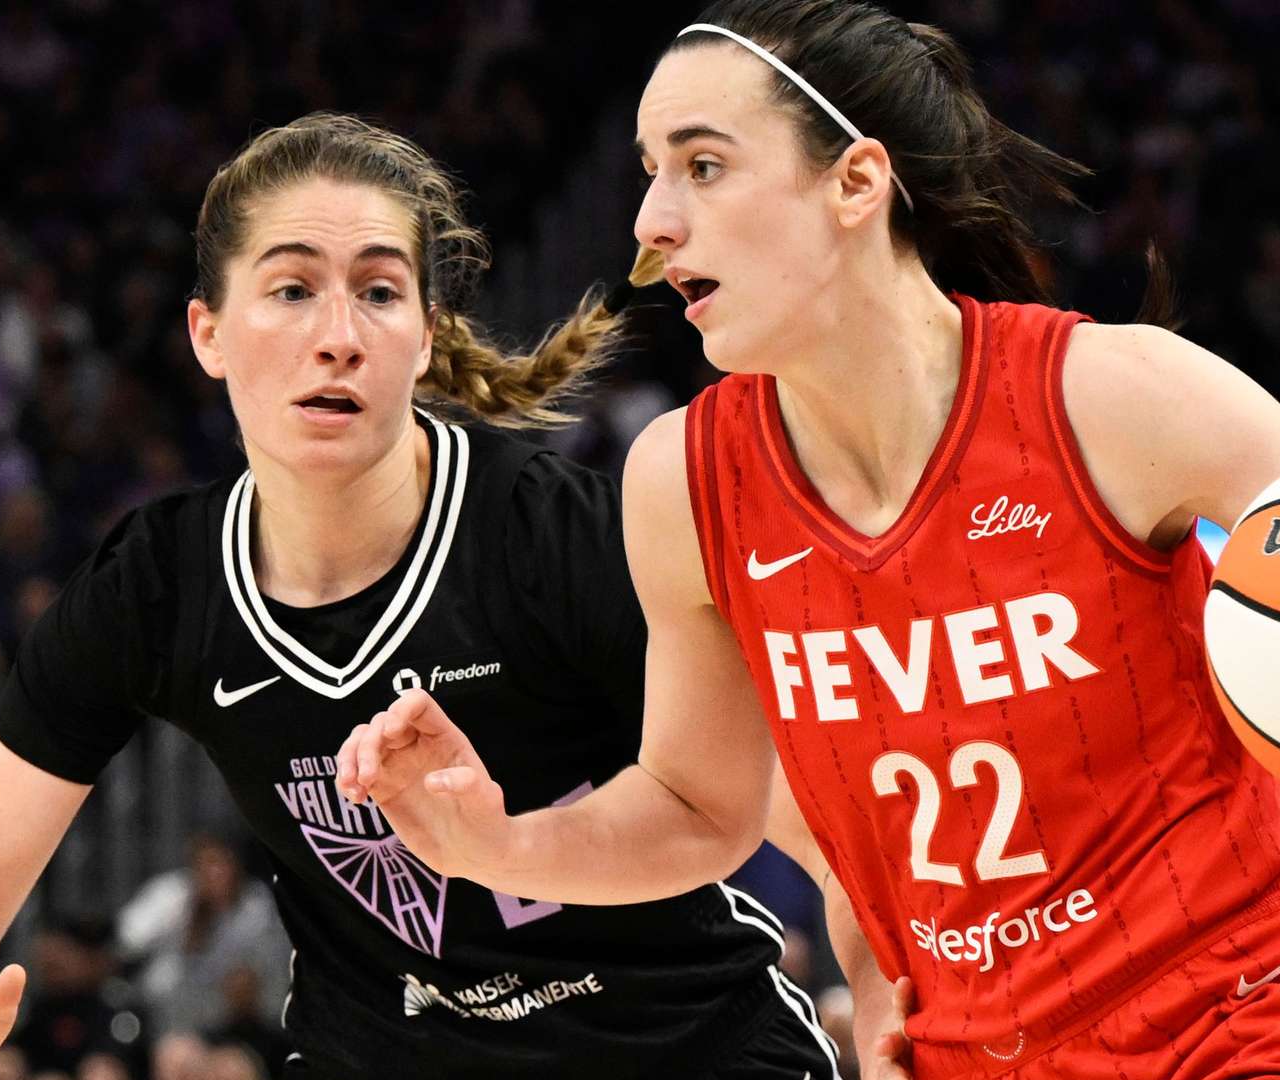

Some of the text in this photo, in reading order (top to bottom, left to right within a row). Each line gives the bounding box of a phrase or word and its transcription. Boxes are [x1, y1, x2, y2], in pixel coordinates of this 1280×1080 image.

[966, 494, 1053, 540] Lilly
[429, 661, 501, 692] freedom
[762, 591, 1102, 723] FEVER
[290, 754, 338, 779] GOLD
[870, 740, 1049, 888] 22
